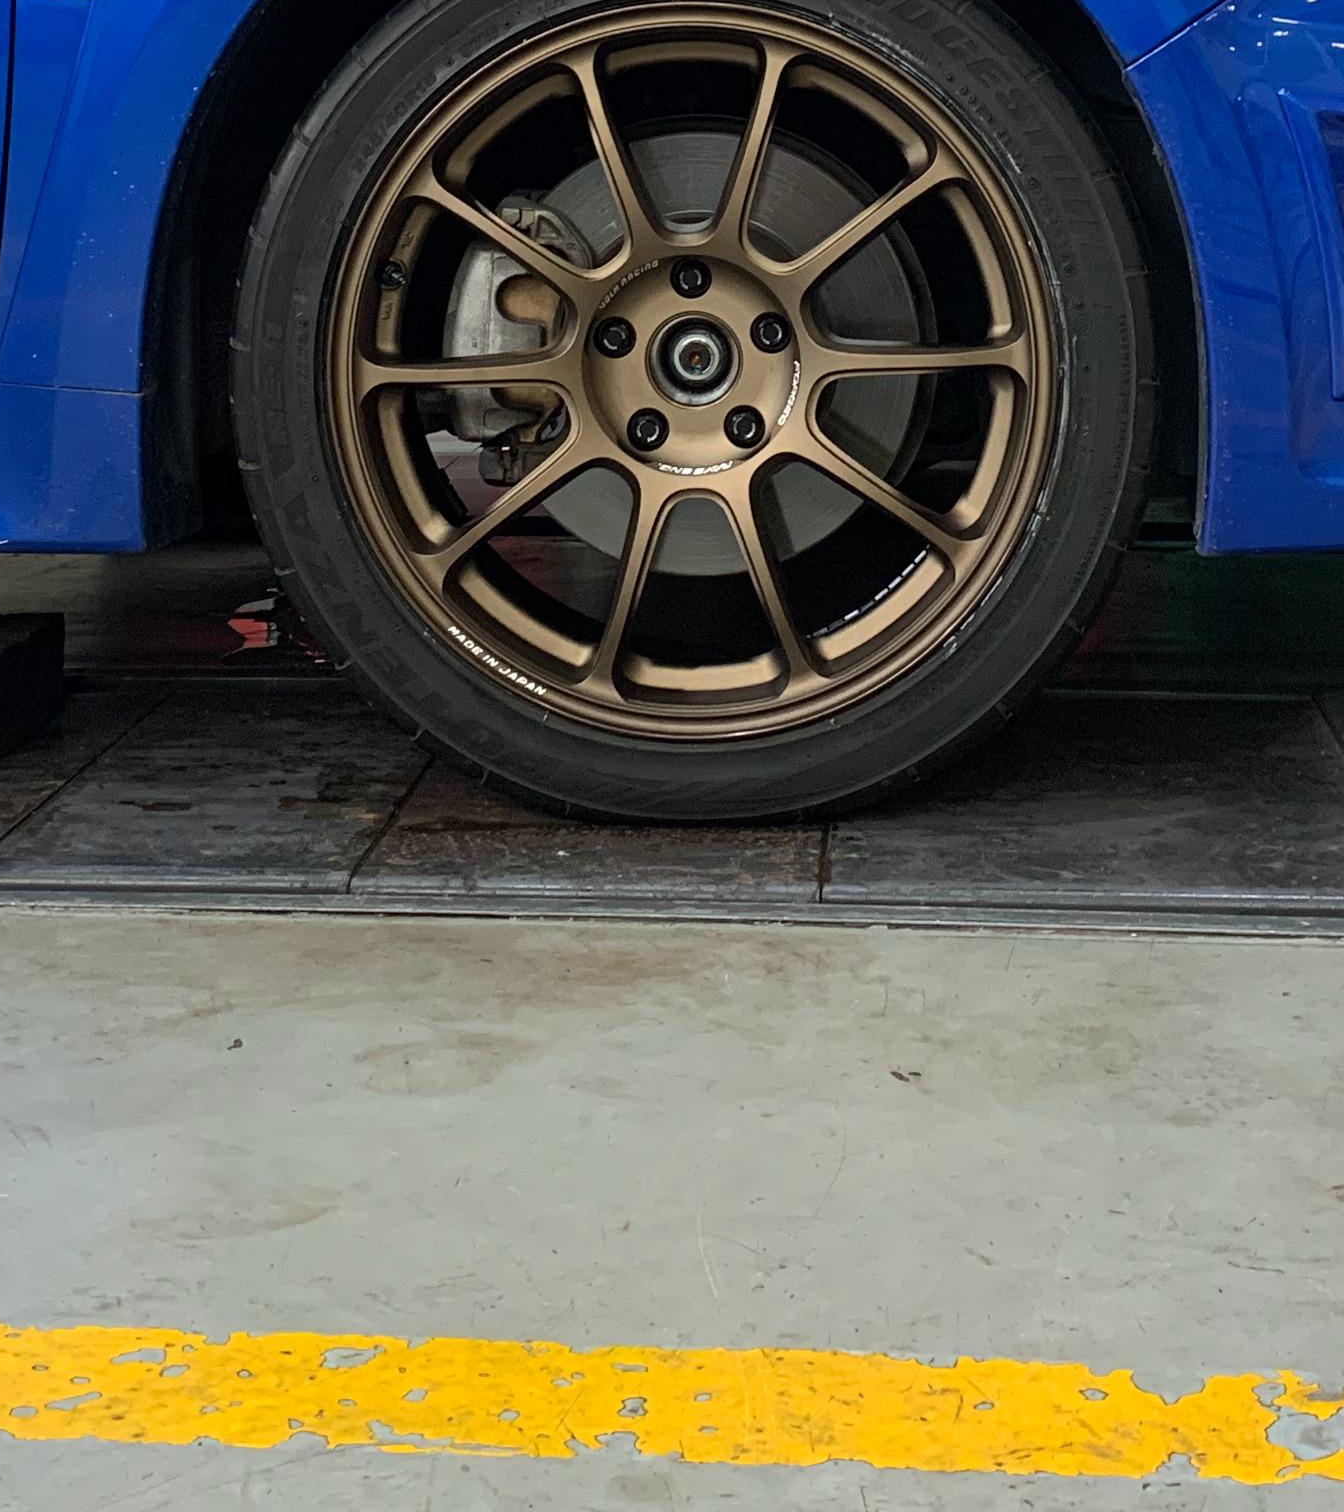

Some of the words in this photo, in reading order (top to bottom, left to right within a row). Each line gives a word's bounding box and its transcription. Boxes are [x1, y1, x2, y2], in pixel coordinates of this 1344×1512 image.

[620, 260, 660, 286] RACING
[777, 360, 801, 426] FORGED
[692, 460, 734, 476] RAYS
[447, 625, 484, 656] MADE
[482, 654, 499, 668] IN
[498, 667, 547, 696] JAPAN
